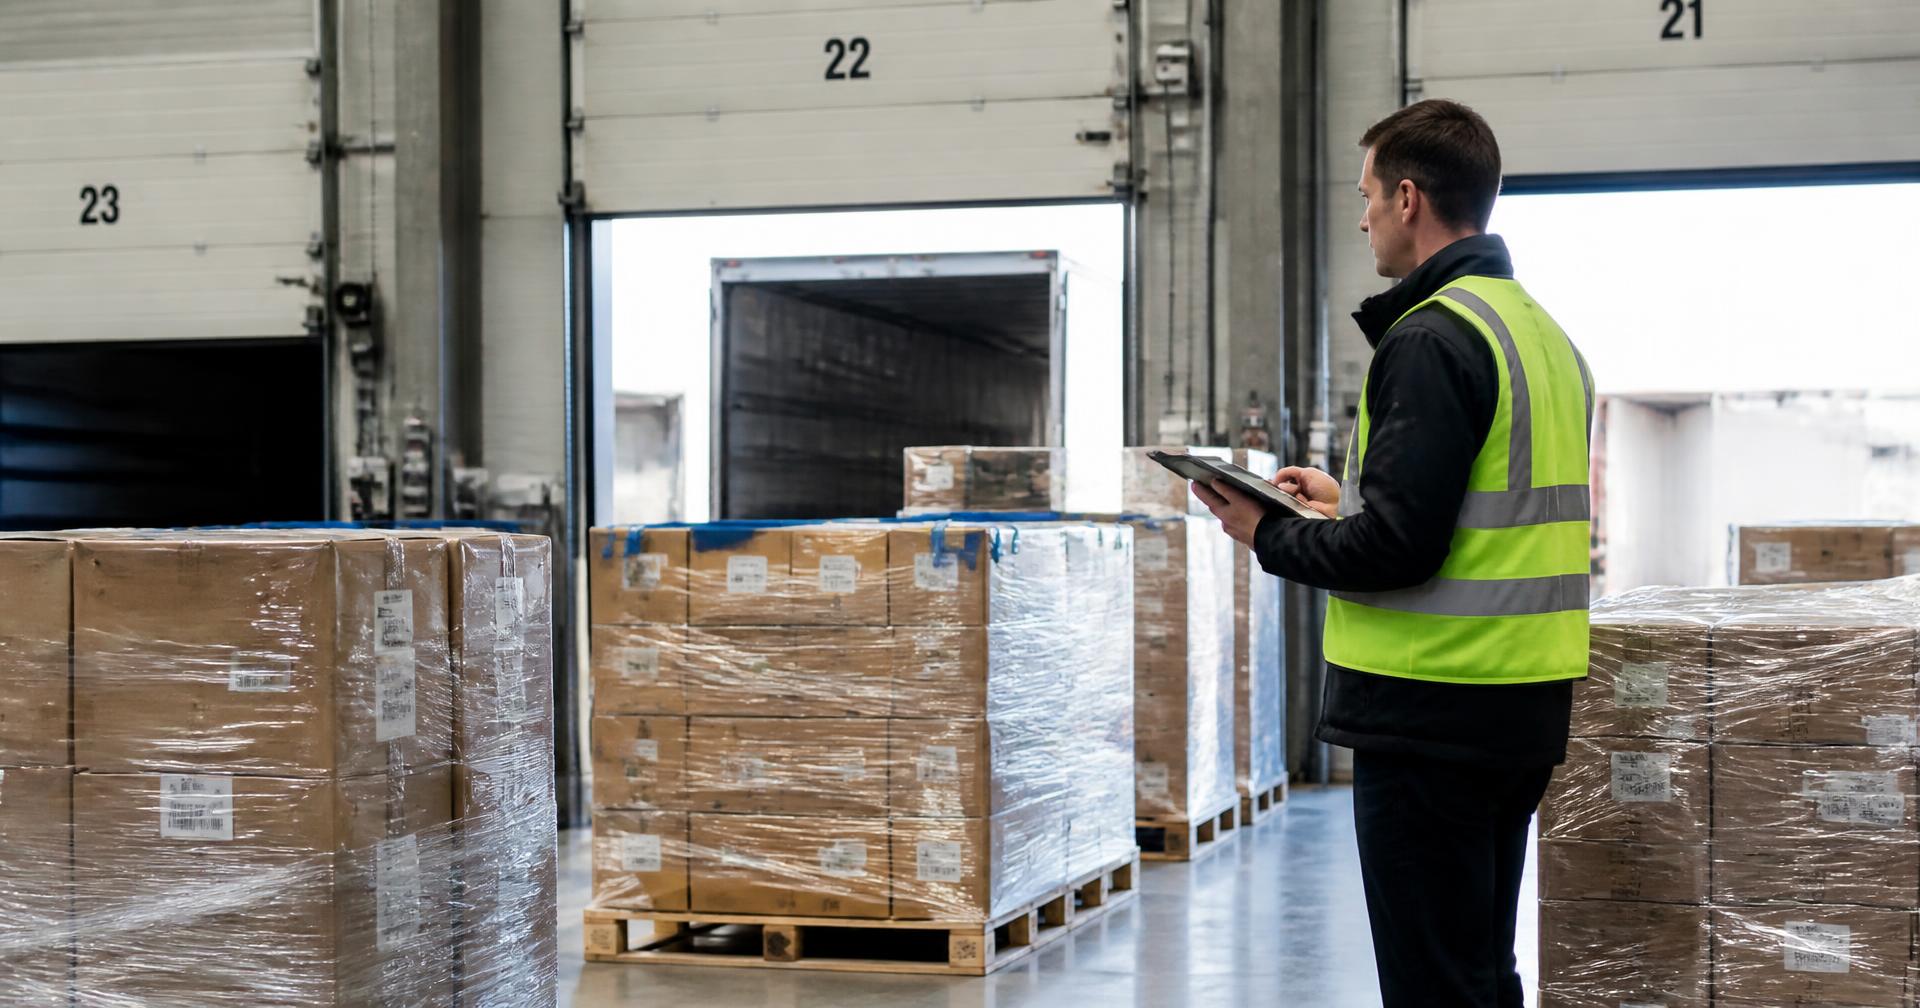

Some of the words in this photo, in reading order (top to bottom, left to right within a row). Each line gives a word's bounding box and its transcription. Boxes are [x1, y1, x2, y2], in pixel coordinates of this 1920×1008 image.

[1660, 0, 1702, 39] 21
[824, 37, 871, 80] 22
[80, 185, 120, 226] 23
